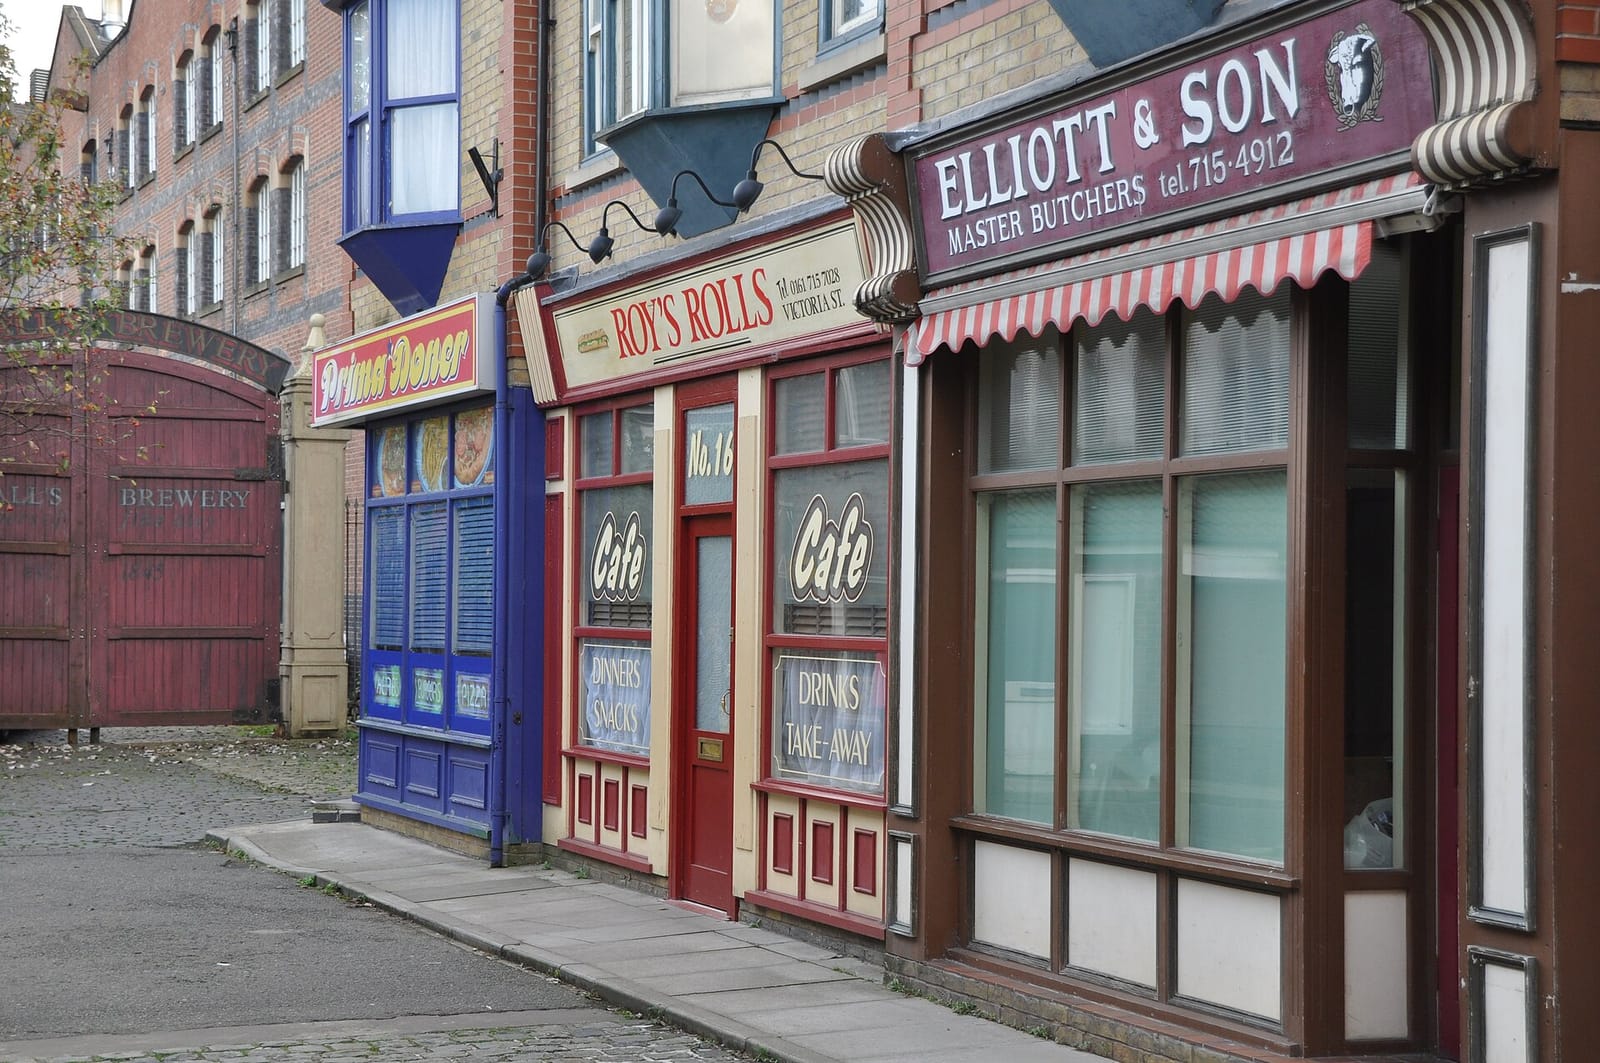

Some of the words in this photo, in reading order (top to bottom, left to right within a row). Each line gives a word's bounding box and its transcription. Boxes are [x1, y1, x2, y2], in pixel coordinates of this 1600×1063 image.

[934, 100, 1116, 220] ELLIOTT
[1133, 99, 1159, 150] &
[1179, 38, 1299, 146] SON
[948, 207, 1024, 256] MASTER
[1031, 175, 1146, 235] BUTCHERS
[789, 278, 807, 295] 0161
[806, 272, 821, 290] 715
[821, 267, 841, 287] 7028
[610, 294, 682, 360] ROY'S
[681, 268, 774, 344] ROLLS
[782, 293, 831, 321] VICTORIA
[830, 288, 846, 310] ST.
[112, 311, 278, 382] BREWERY
[321, 352, 388, 414] Prima
[388, 329, 470, 396] Doner
[120, 488, 250, 509] BREWERY
[592, 520, 644, 592] Cafe
[793, 505, 869, 592] Cafe
[592, 656, 641, 689] DINNERS
[799, 670, 860, 711] DRINKS
[462, 683, 487, 709] PIZZA
[593, 699, 639, 733] SNACKS
[785, 721, 873, 766] TAKE-AWAY
